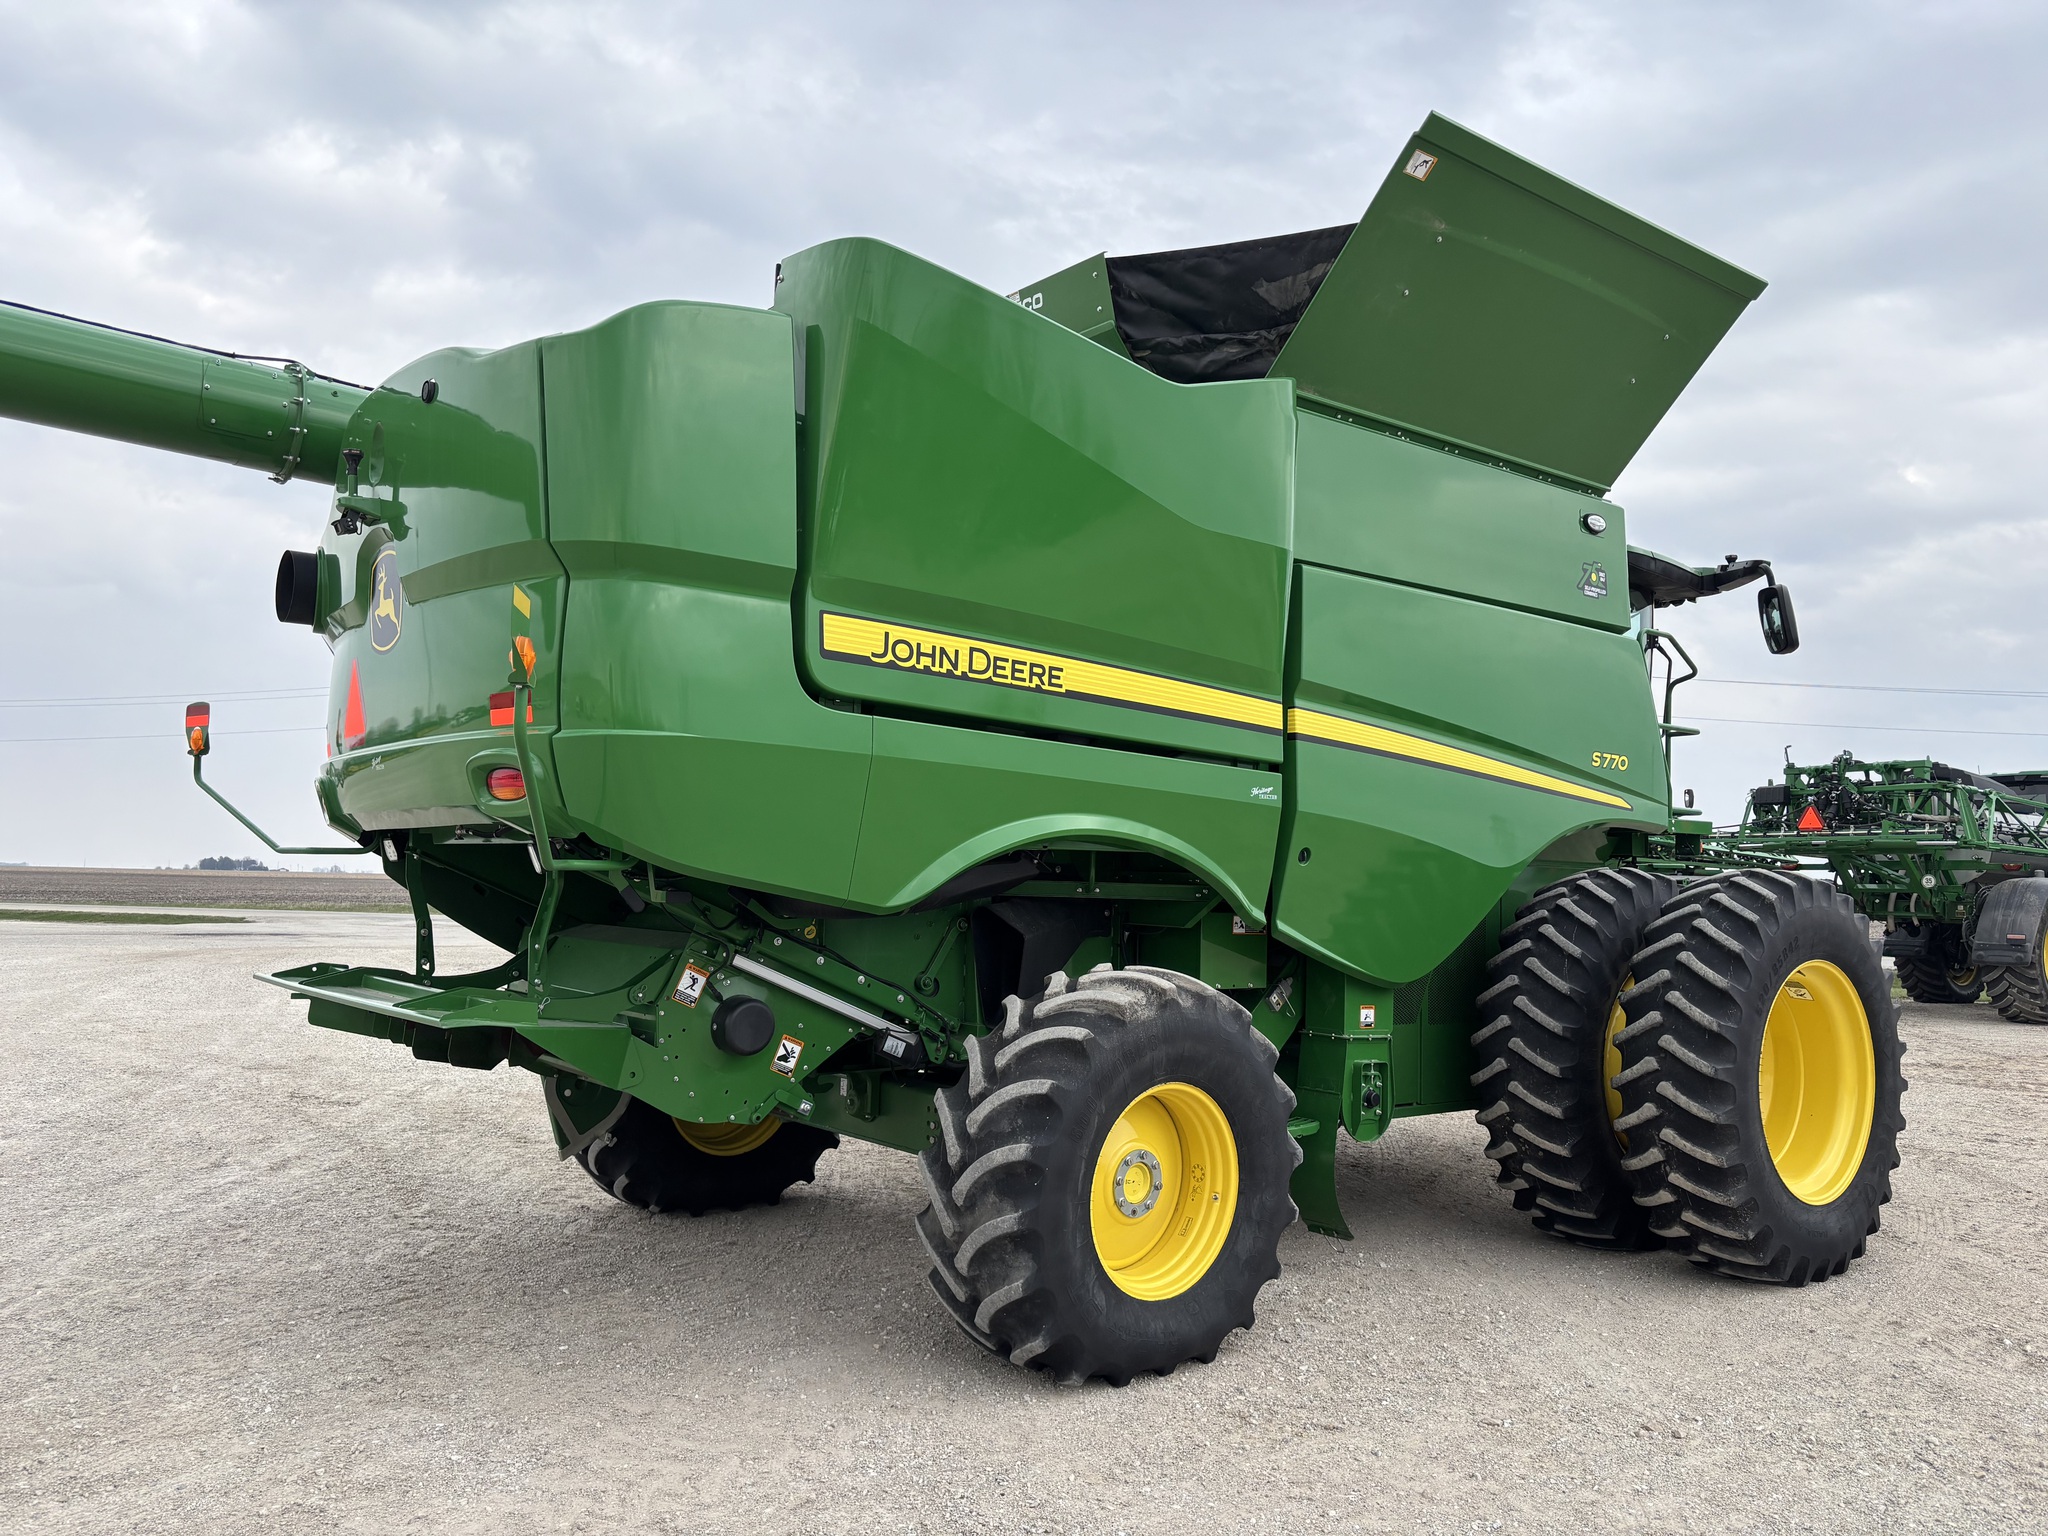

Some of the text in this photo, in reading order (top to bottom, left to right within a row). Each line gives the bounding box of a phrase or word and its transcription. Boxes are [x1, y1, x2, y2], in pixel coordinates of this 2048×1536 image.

[871, 631, 1064, 689] JOHN DEERE
[1591, 751, 1629, 771] S770
